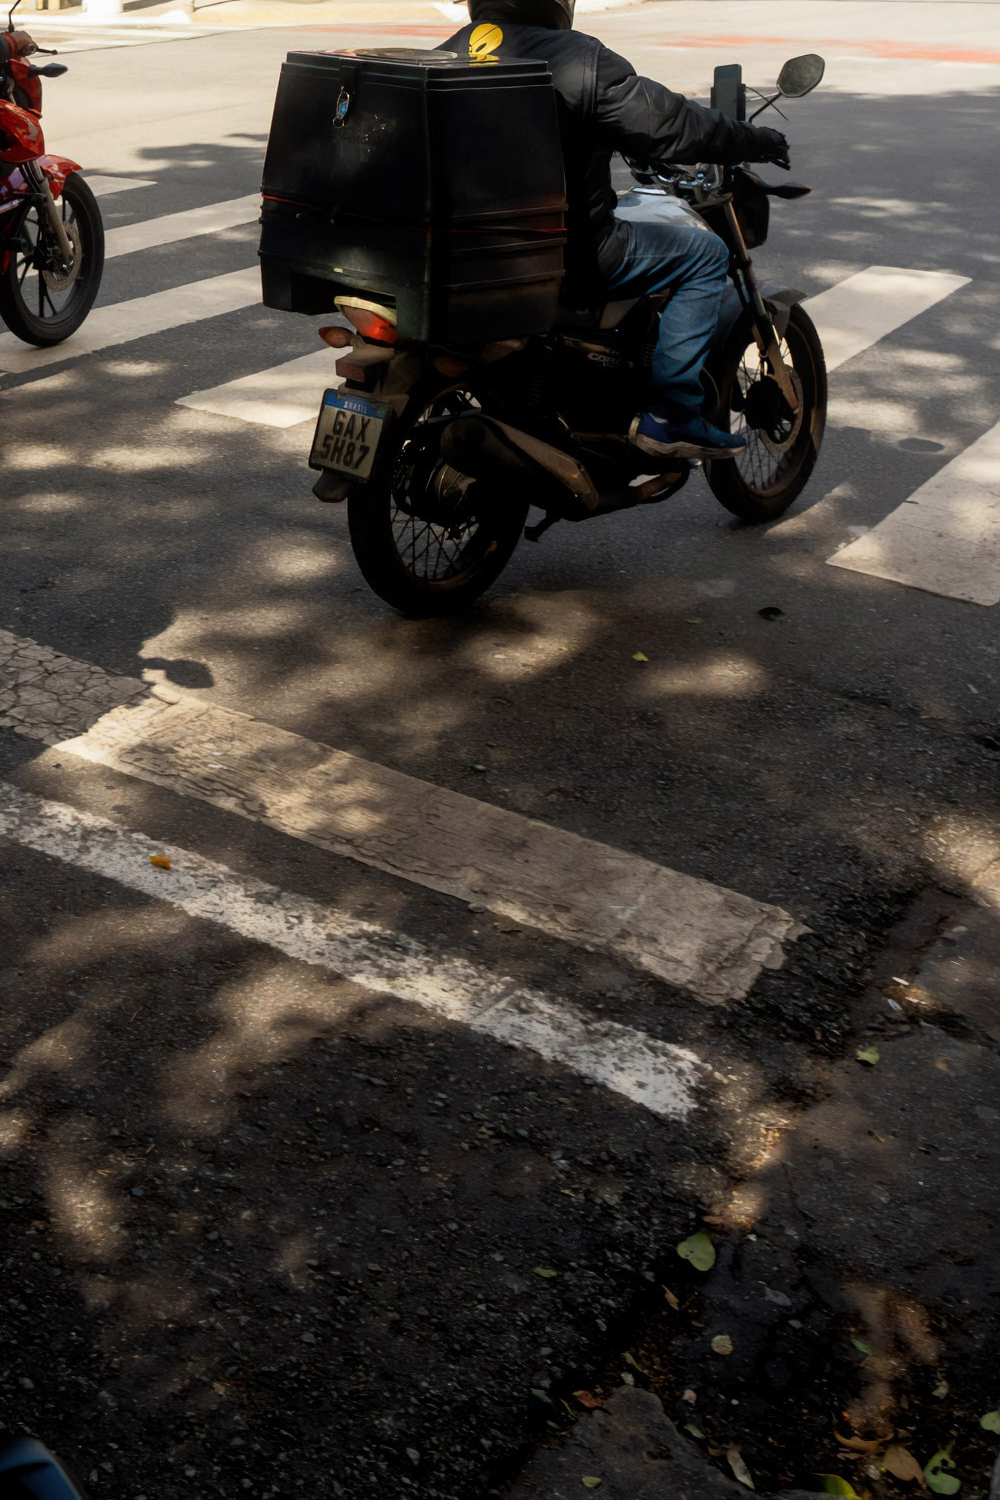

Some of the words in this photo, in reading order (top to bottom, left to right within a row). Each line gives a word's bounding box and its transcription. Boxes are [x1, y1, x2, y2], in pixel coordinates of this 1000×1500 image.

[343, 401, 368, 414] BRASIL
[333, 410, 371, 442] GAX
[319, 434, 370, 469] 5H87
